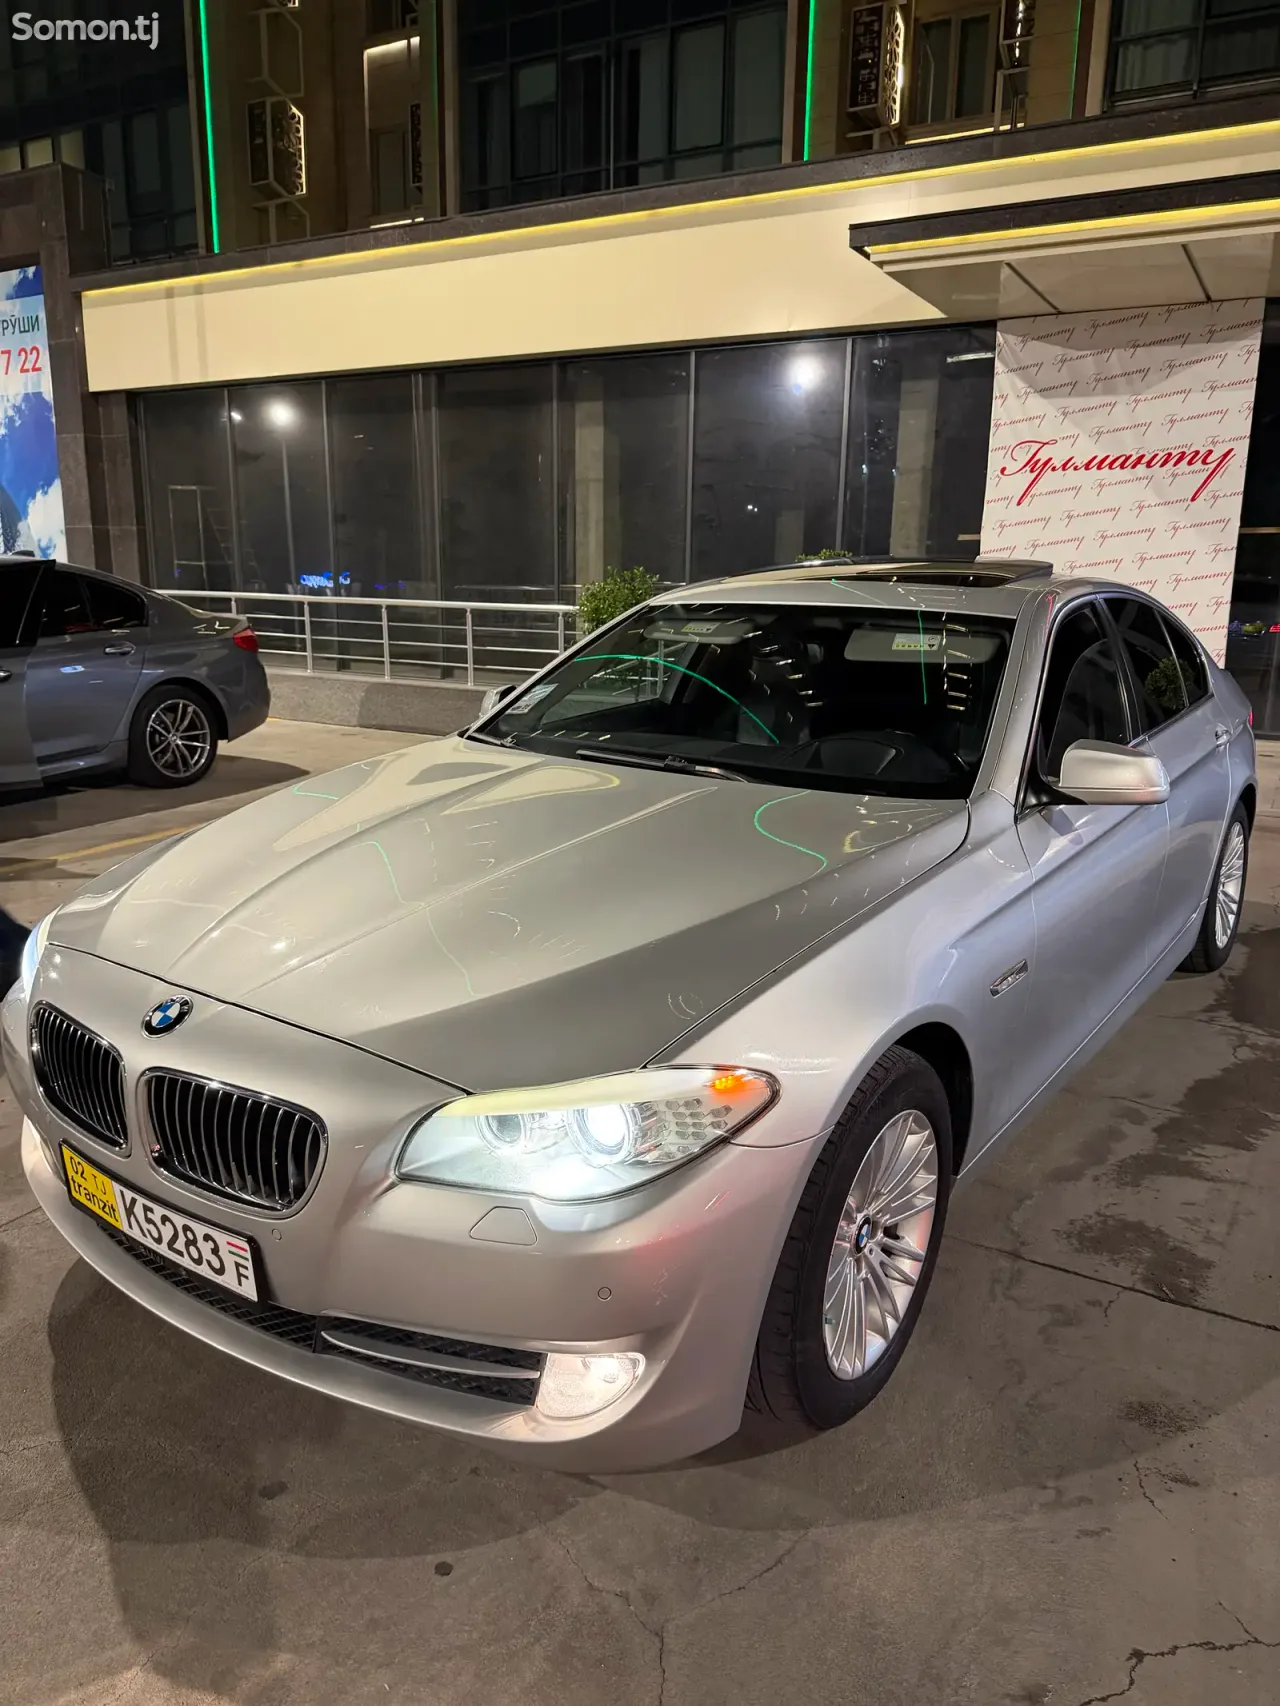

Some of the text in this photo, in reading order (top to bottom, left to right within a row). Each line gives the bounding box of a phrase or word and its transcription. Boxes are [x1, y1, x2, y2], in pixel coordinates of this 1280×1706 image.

[0, 314, 40, 336] РӮШИ
[1014, 327, 1075, 353] Гулманту
[1084, 311, 1149, 339] Гулманту
[0, 345, 42, 375] 7 22
[1052, 347, 1115, 373] Гулманту
[1124, 332, 1191, 359] Гулманту
[1200, 318, 1263, 344] Гулмант
[1017, 380, 1077, 405] Гулманту
[1086, 366, 1151, 392] Гулманту
[1160, 352, 1228, 379] Гулманту
[1055, 400, 1117, 425] Гулманту
[1126, 388, 1192, 413] Гулманту
[1089, 420, 1152, 445] Гулманту
[1161, 408, 1229, 434] Гулманту
[1000, 439, 1236, 506] Гулманту
[1030, 484, 1082, 507] улманту
[1091, 474, 1154, 497] Гулманту
[992, 516, 1051, 537] Гулманту
[1060, 506, 1121, 528] Гулманту
[1024, 536, 1085, 557] Гулманту
[1093, 527, 1156, 549] Гулманту
[1164, 517, 1231, 540] Гулманту
[1062, 558, 1123, 573] Гулманту
[1131, 549, 1196, 570] Гулманту
[1166, 571, 1232, 592] Гулманту
[69, 1156, 107, 1193] 02 TJ
[71, 1175, 118, 1223] tranzit
[120, 1189, 249, 1287] K5283 F
